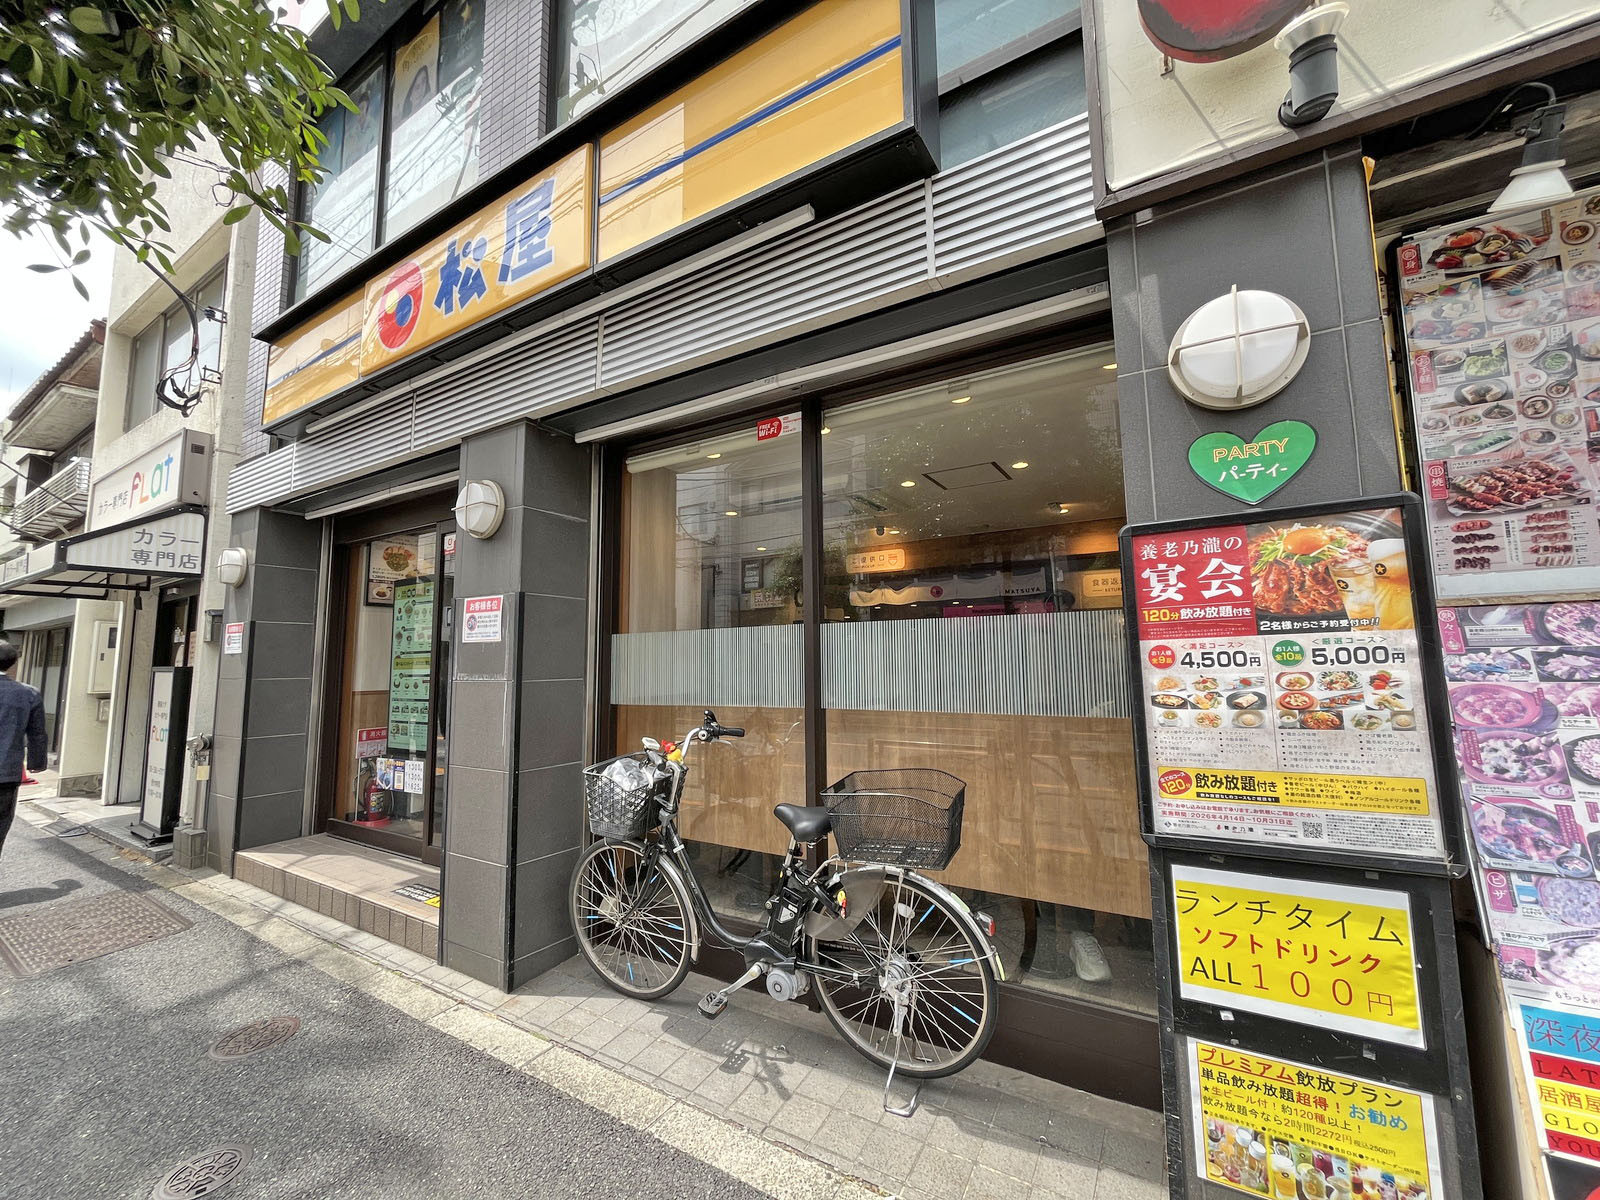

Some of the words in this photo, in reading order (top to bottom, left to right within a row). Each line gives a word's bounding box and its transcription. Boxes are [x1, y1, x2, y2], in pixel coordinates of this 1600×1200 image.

[433, 177, 556, 317] 松屋
[759, 426, 778, 437] Wi-Fi
[1213, 437, 1290, 463] PARTY
[1219, 463, 1288, 482] パーティー
[133, 528, 199, 546] カラー
[1141, 536, 1243, 560] 養老乃瀧の
[131, 549, 199, 569] 専門店
[1092, 577, 1121, 586] 食器返
[1141, 558, 1245, 604] 宴会
[469, 600, 498, 611] お客様各位
[1142, 605, 1252, 622] 120分飲み放題付き
[1151, 655, 1173, 665] 全9品
[1180, 650, 1262, 669] 4,500円
[1275, 652, 1303, 661] 全10品
[1312, 645, 1406, 666] 5,000円
[1195, 772, 1278, 793] 飲み放題付き
[1176, 889, 1404, 945] ランチタイム
[1194, 927, 1381, 974] ソフトドリンク
[1190, 956, 1242, 986] ALL
[1523, 1014, 1600, 1053] 深夜
[1200, 1048, 1403, 1108] プレミアム飲放プラン
[1539, 1084, 1600, 1114] 居酒屋
[1349, 1103, 1409, 1132] お勧め
